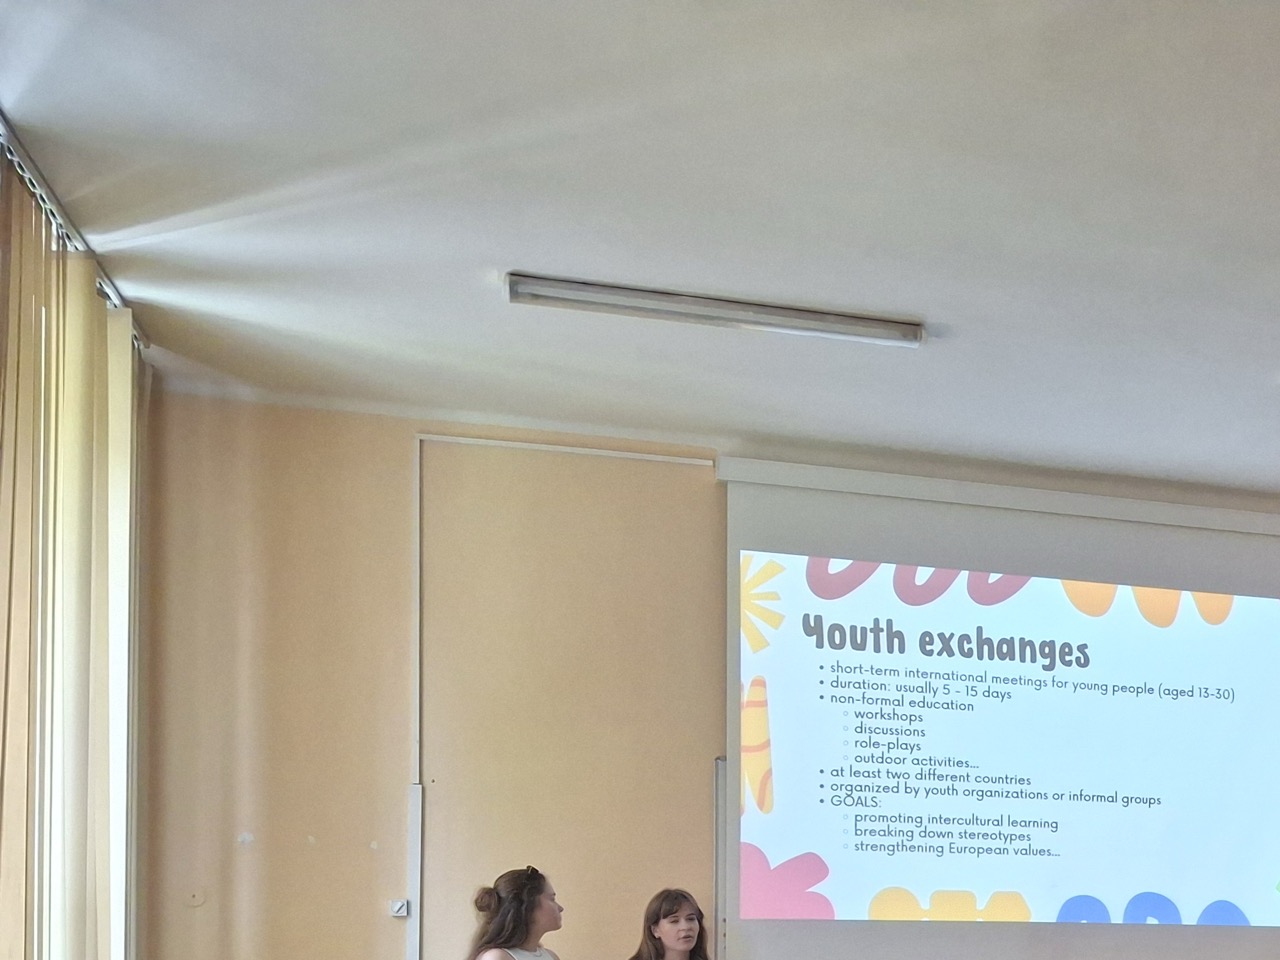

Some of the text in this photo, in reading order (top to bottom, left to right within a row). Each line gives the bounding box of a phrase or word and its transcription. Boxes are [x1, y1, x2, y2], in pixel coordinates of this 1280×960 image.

[802, 613, 1090, 671] Youth exchanges
[830, 660, 1235, 703] short-term international meetings for young people (aged 13-30)
[830, 675, 891, 692] duration:
[896, 681, 939, 698] usually
[942, 685, 951, 696] 5
[965, 685, 978, 697] 15
[982, 686, 1012, 702] days
[830, 692, 974, 711] non-formal education
[854, 708, 924, 725] workshops
[854, 721, 926, 737] discussions
[854, 736, 921, 754] role-plays
[855, 751, 907, 765] outdoor
[830, 764, 1032, 785] at least two different countries
[830, 781, 1162, 808] organized by youth organizations or informal groups
[830, 794, 882, 808] GOALS:
[855, 813, 1059, 833] promoting intercultural learning
[855, 824, 1032, 845] breaking down stereotypes
[855, 839, 944, 857] strengthening
[949, 842, 1009, 858] European
